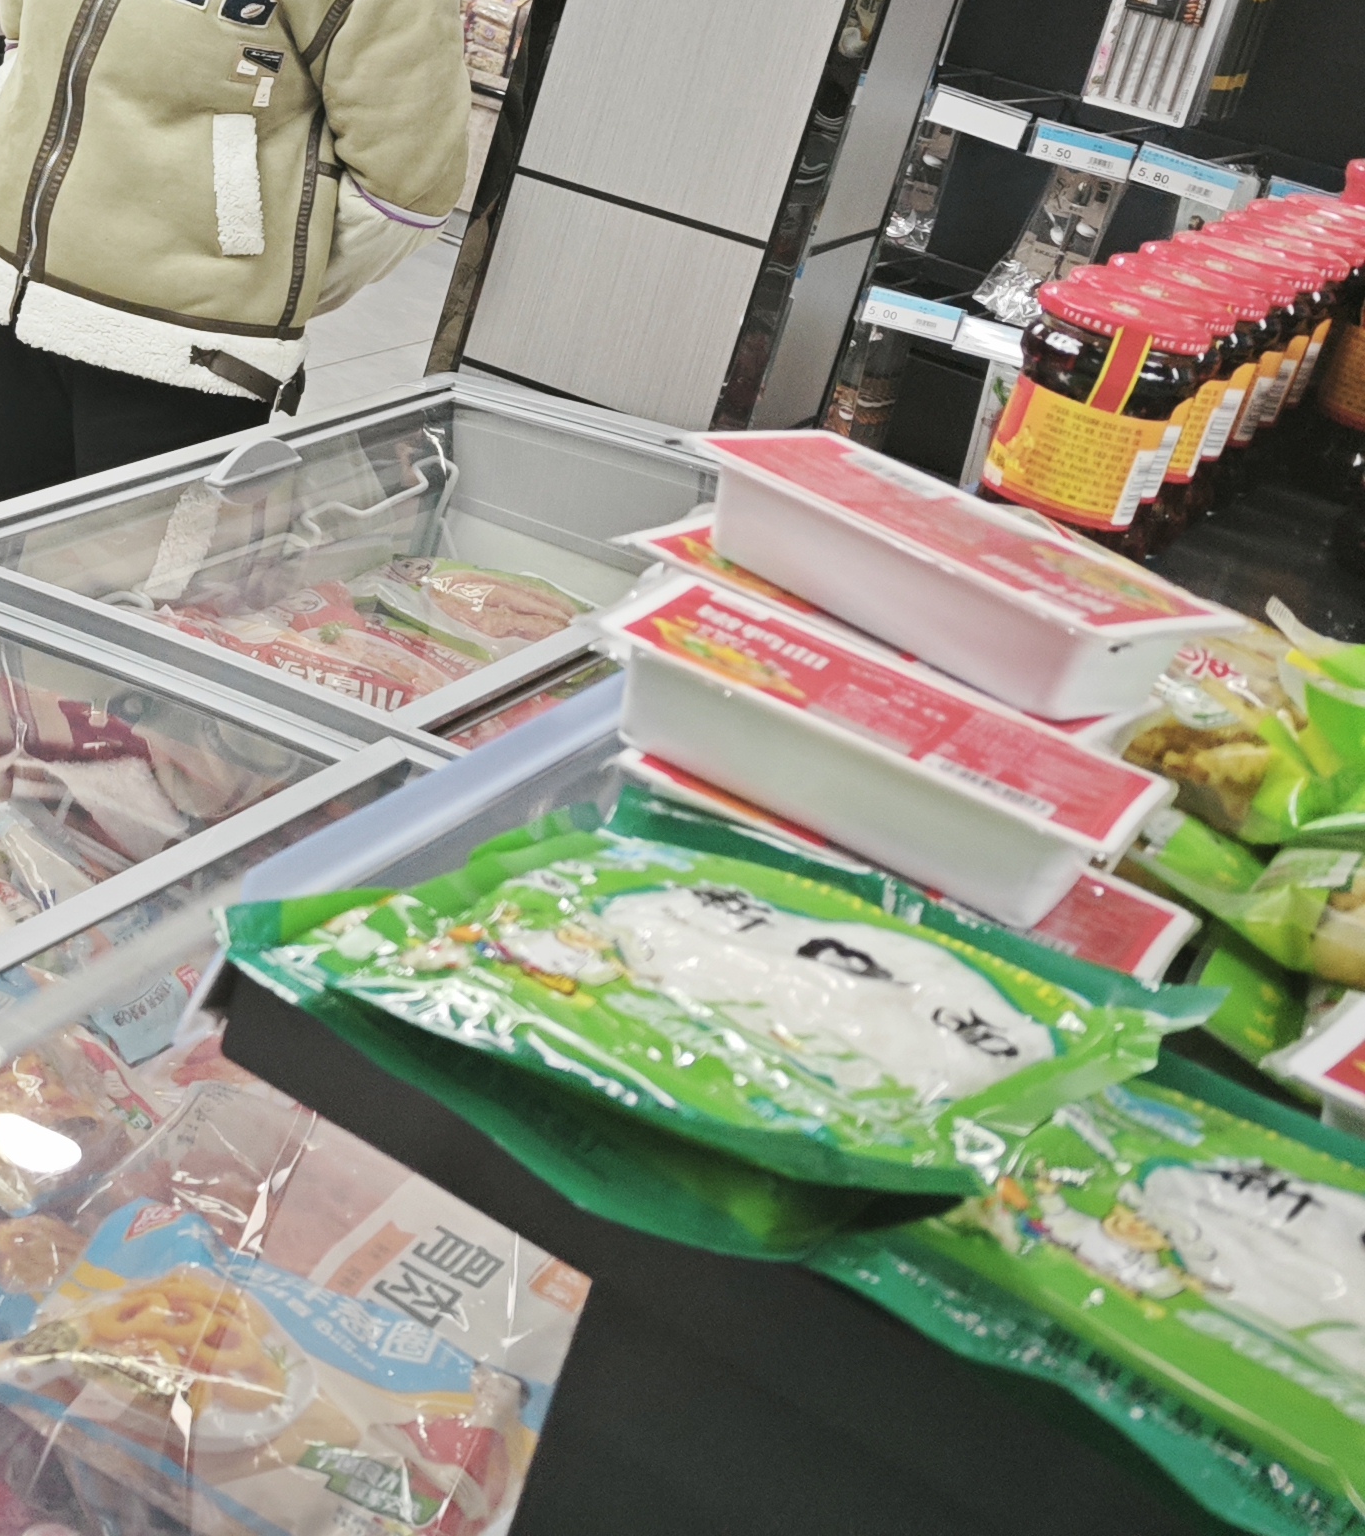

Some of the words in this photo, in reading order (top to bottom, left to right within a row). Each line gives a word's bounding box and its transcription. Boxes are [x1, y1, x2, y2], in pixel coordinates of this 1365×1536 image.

[1040, 143, 1072, 160] 3.50
[1137, 167, 1170, 185] 5.80
[868, 304, 898, 321] 5.00
